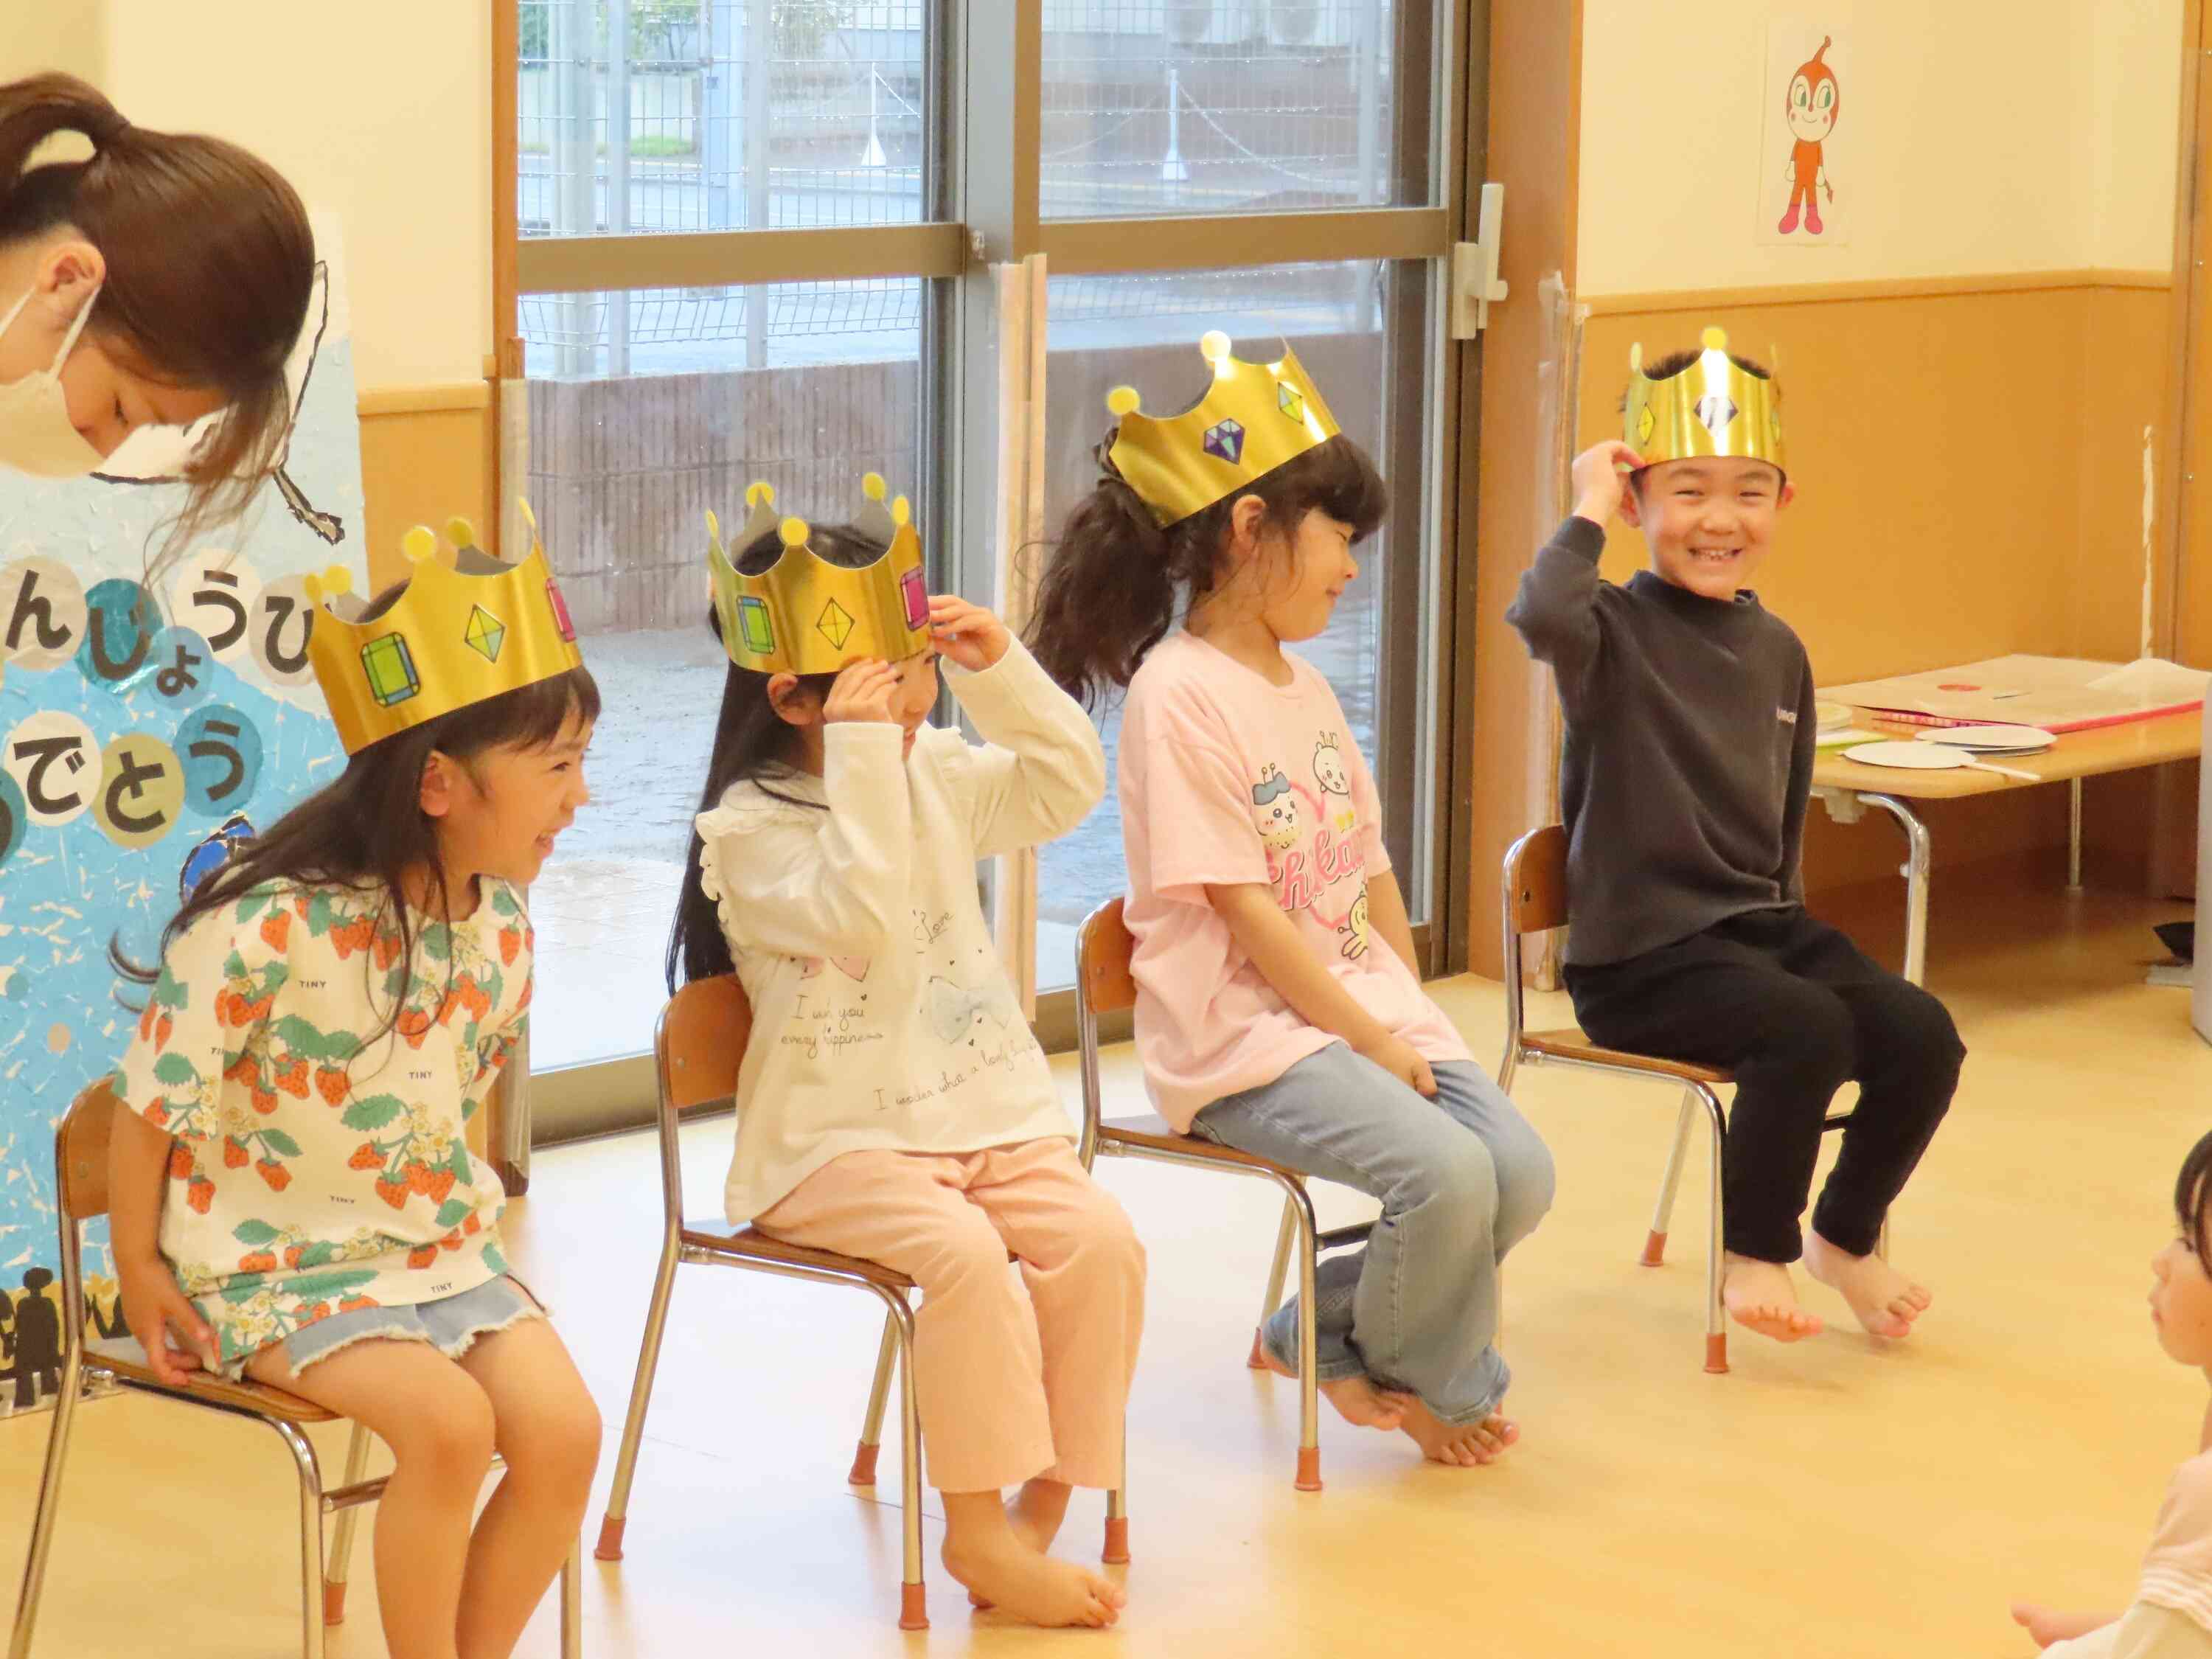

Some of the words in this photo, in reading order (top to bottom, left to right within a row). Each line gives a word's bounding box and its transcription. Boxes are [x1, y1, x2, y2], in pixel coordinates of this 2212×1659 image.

[0, 720, 245, 858] でとう
[298, 979, 327, 990] TINY
[790, 994, 809, 1019] I
[838, 1008, 865, 1032] you
[408, 1070, 432, 1079] TINY
[873, 1087, 888, 1110] I
